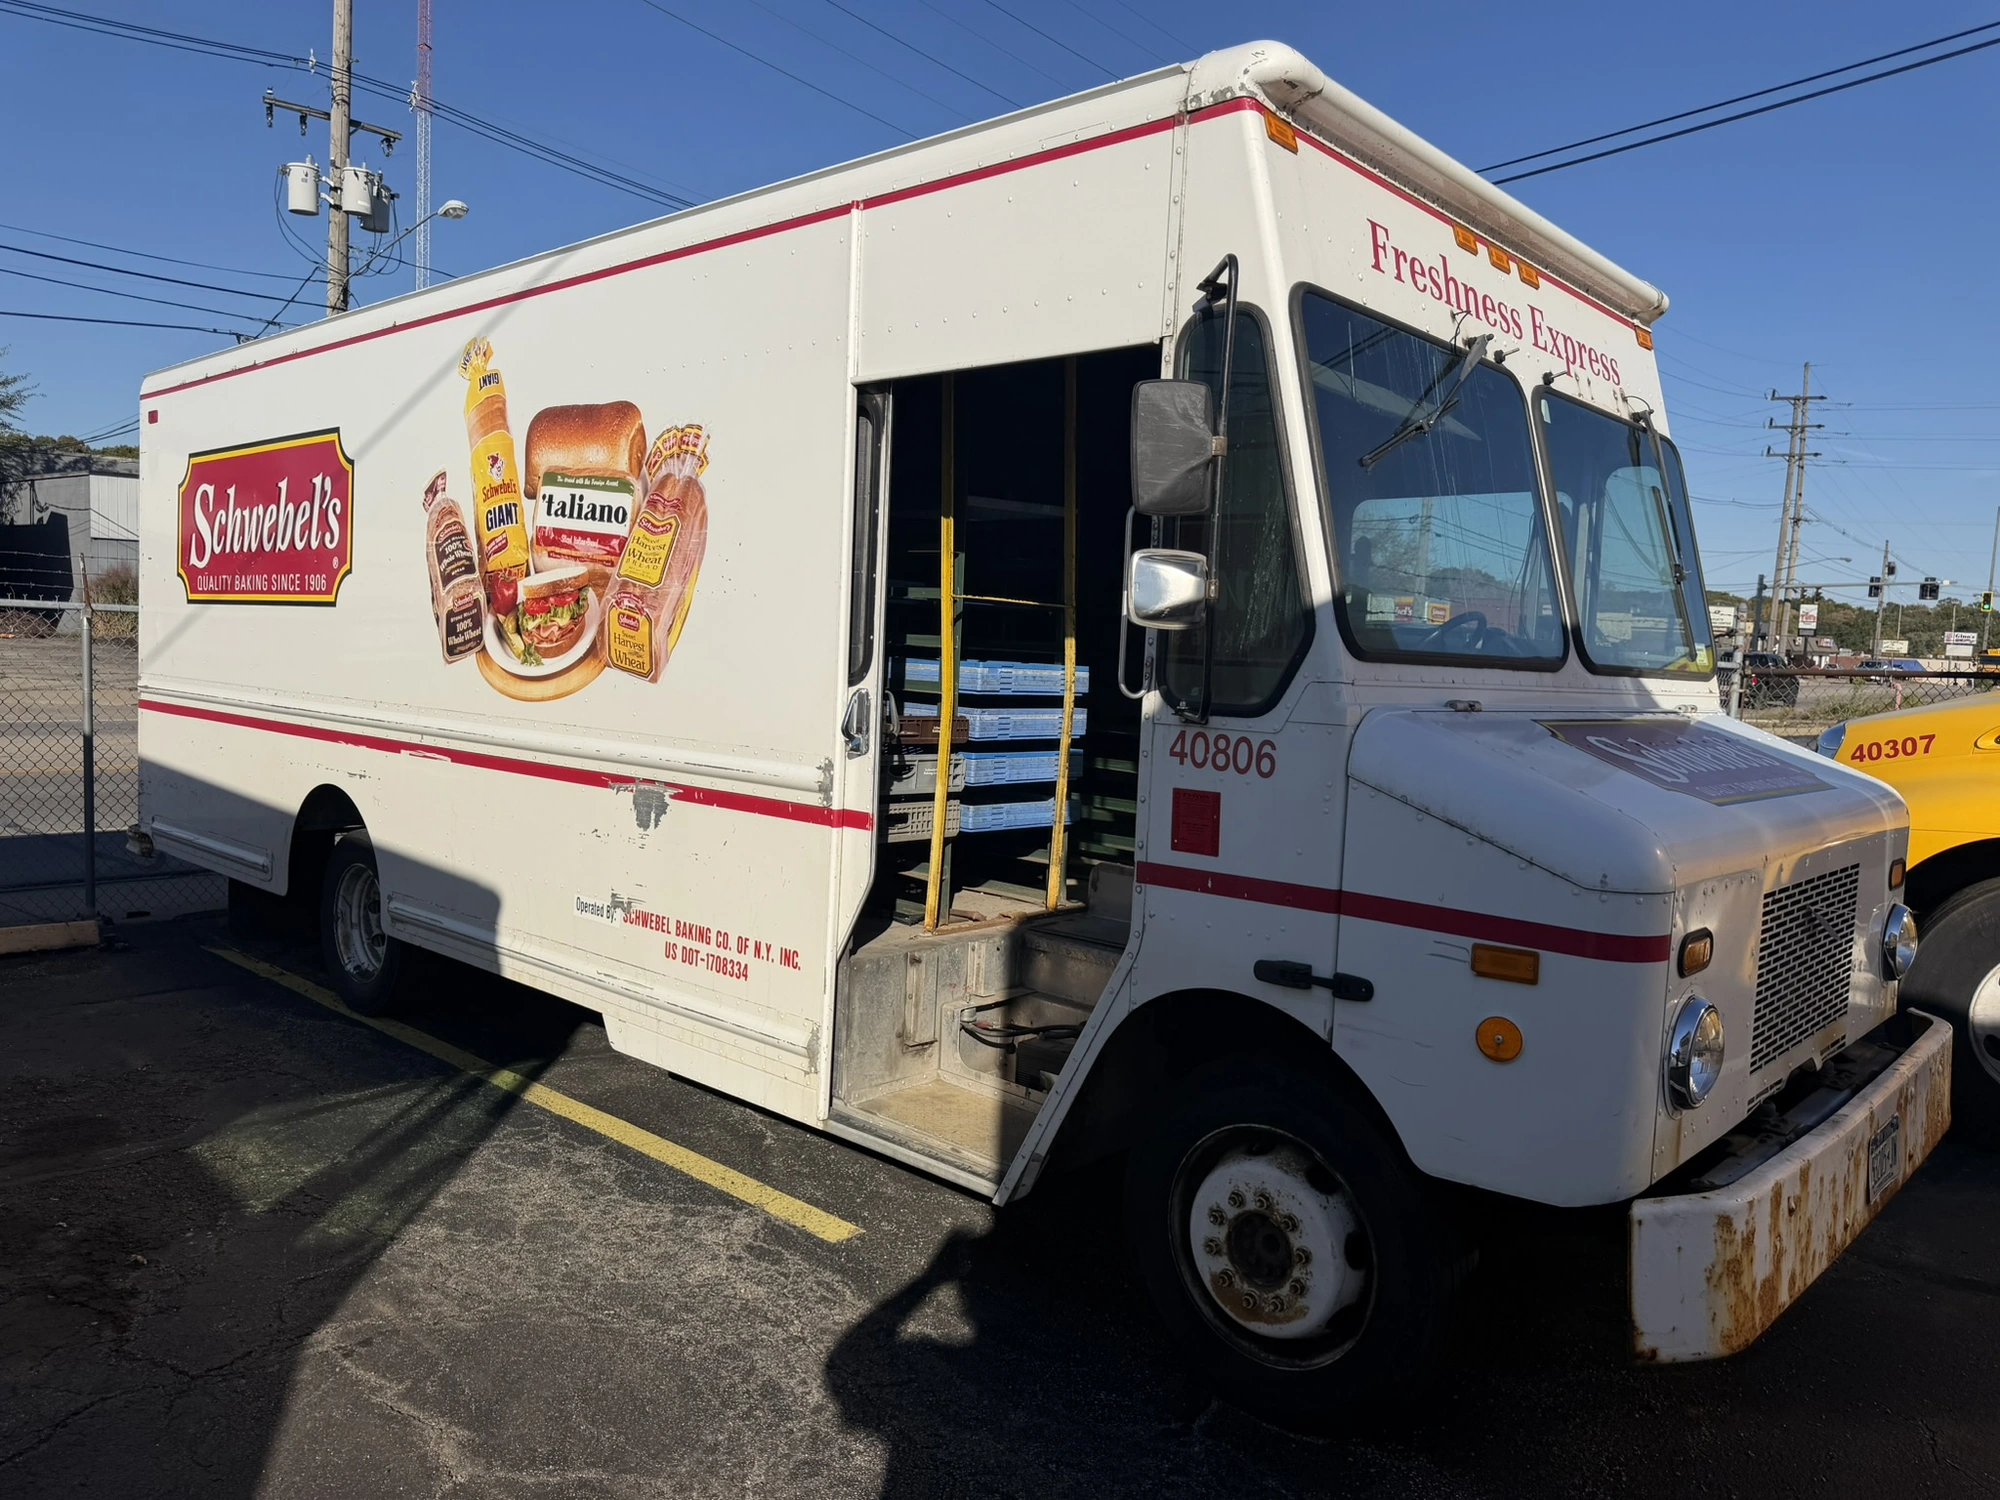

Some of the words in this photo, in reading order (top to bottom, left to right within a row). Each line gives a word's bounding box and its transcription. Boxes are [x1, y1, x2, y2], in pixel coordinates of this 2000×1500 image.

[1366, 217, 1524, 340] Freshness
[1527, 303, 1622, 386] Express
[478, 372, 500, 391] GIANT
[482, 478, 518, 503] Schwebel's
[188, 471, 342, 569] Schwebel's
[486, 502, 518, 532] GIANT
[541, 493, 628, 525] 'taliano
[641, 518, 672, 532] Schwebel's
[445, 540, 462, 554] 100%
[632, 536, 666, 551] Harvest
[440, 554, 455, 572] Whole
[626, 558, 658, 570] BREAD
[628, 548, 662, 564] Wheat
[197, 573, 232, 591] QUALITY
[234, 573, 268, 591] BAKING
[271, 573, 301, 591] SINCE
[304, 573, 327, 592] 1906
[448, 634, 464, 646] Whole
[464, 626, 482, 641] Wheat
[456, 618, 473, 632] 100%
[614, 632, 645, 652] Harvest
[614, 648, 646, 670] Wheat
[1169, 730, 1276, 778] 40806
[1850, 734, 1936, 762] 40307
[1585, 735, 1781, 784] Schwebel's
[576, 896, 604, 918] Operated
[606, 904, 618, 924] By:
[622, 907, 672, 936] SCHWEBEL
[676, 919, 712, 946] BAKING
[715, 930, 732, 952] CO.
[736, 936, 750, 956] OF
[754, 940, 774, 963] N.Y.
[780, 946, 802, 970] INC.
[664, 941, 678, 960] US
[681, 944, 749, 982] DOT-1708334
